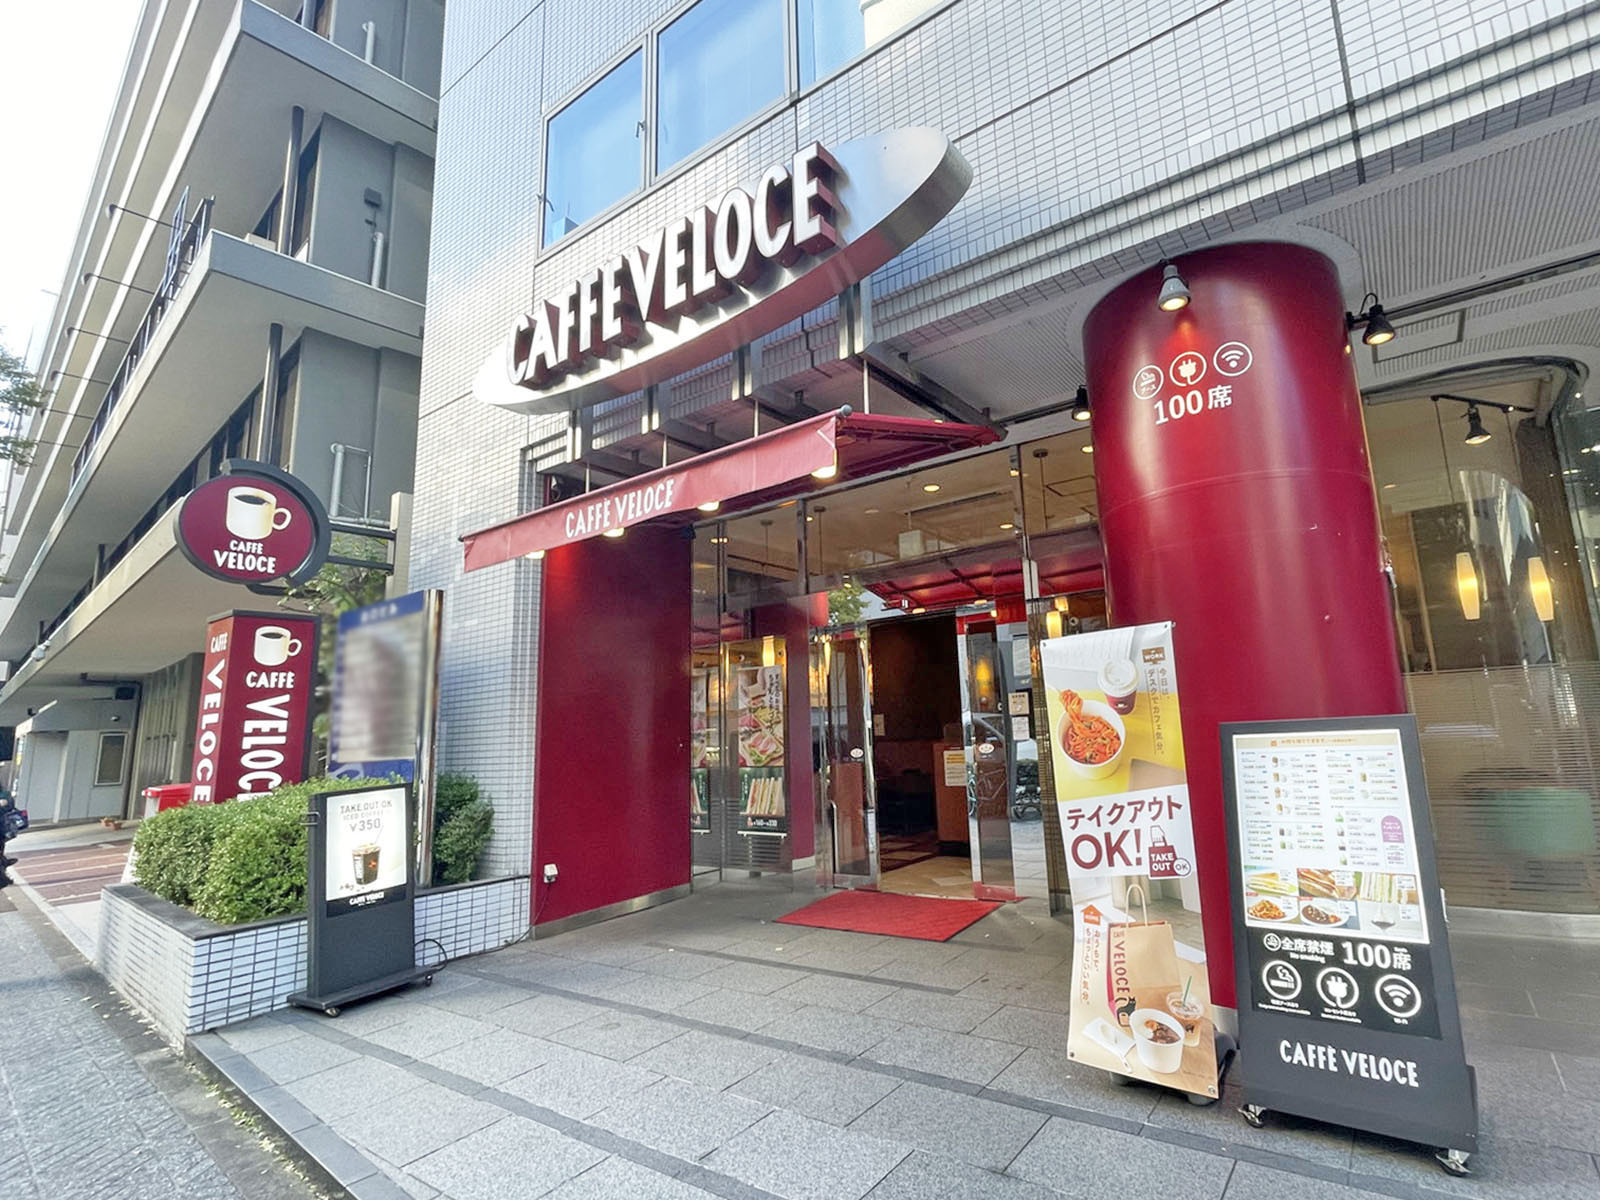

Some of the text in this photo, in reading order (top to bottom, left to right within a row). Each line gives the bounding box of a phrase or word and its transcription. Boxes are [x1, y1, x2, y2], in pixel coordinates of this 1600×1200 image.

[627, 140, 828, 322] VELOCE
[1154, 384, 1233, 425] 100席
[615, 478, 674, 522] VELOCE
[213, 549, 277, 574] VELOCE
[193, 658, 226, 802] VELOCE
[340, 799, 393, 815] TAKE OUT OK
[1066, 794, 1183, 830] テイクアウト
[1071, 828, 1143, 870] OK!
[1151, 852, 1175, 862] TAKE
[1152, 862, 1171, 872] OUT
[1175, 863, 1189, 872] OK
[1281, 936, 1335, 956] 全席禁煙
[1342, 941, 1411, 971] 100席
[1113, 940, 1130, 993] VELOCE
[1341, 1049, 1420, 1088] VELOCE
